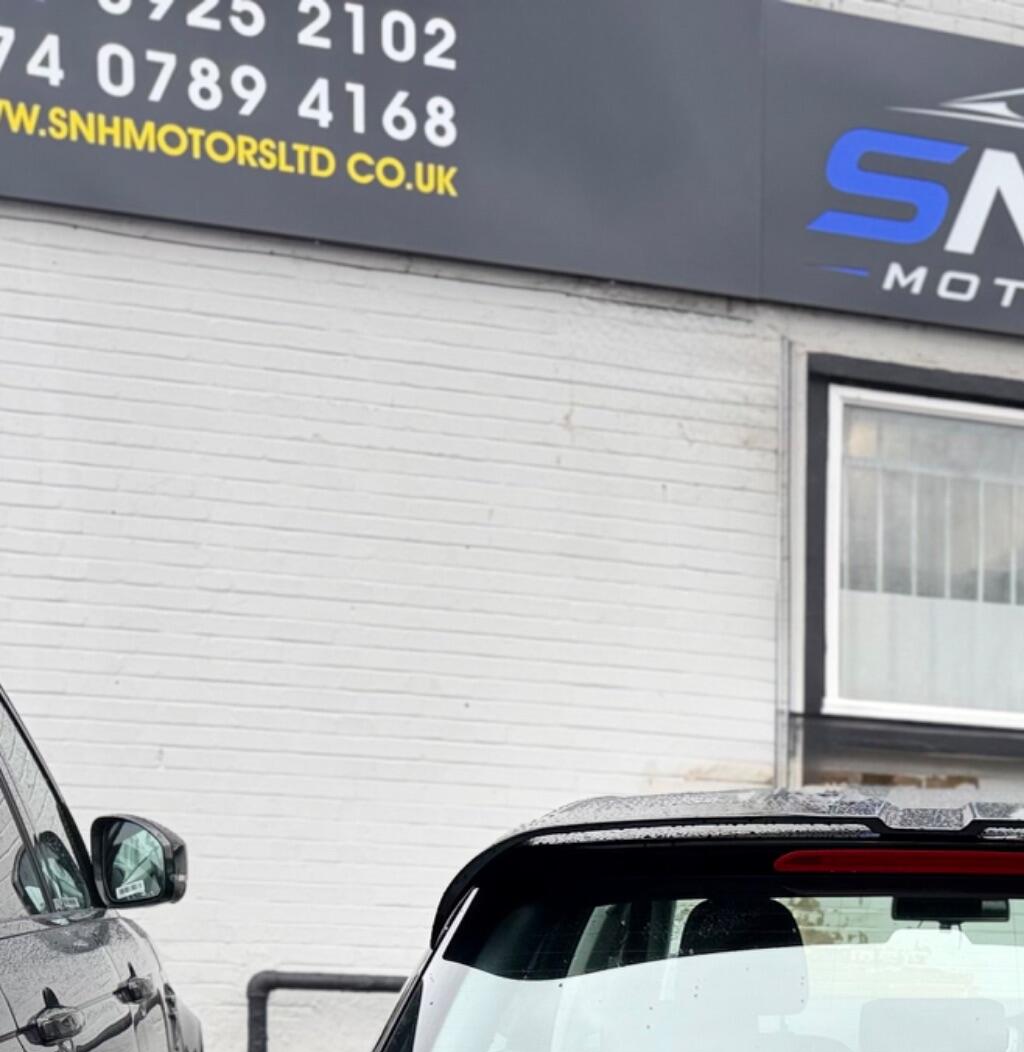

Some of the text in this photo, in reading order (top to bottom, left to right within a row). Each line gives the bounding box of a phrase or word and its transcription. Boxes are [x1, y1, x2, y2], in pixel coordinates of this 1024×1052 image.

[97, 0, 458, 71] 25 2102
[97, 43, 268, 117] 0789
[298, 78, 458, 148] 4168
[0, 98, 458, 196] W.SNHMOTORSLTD CO.UK
